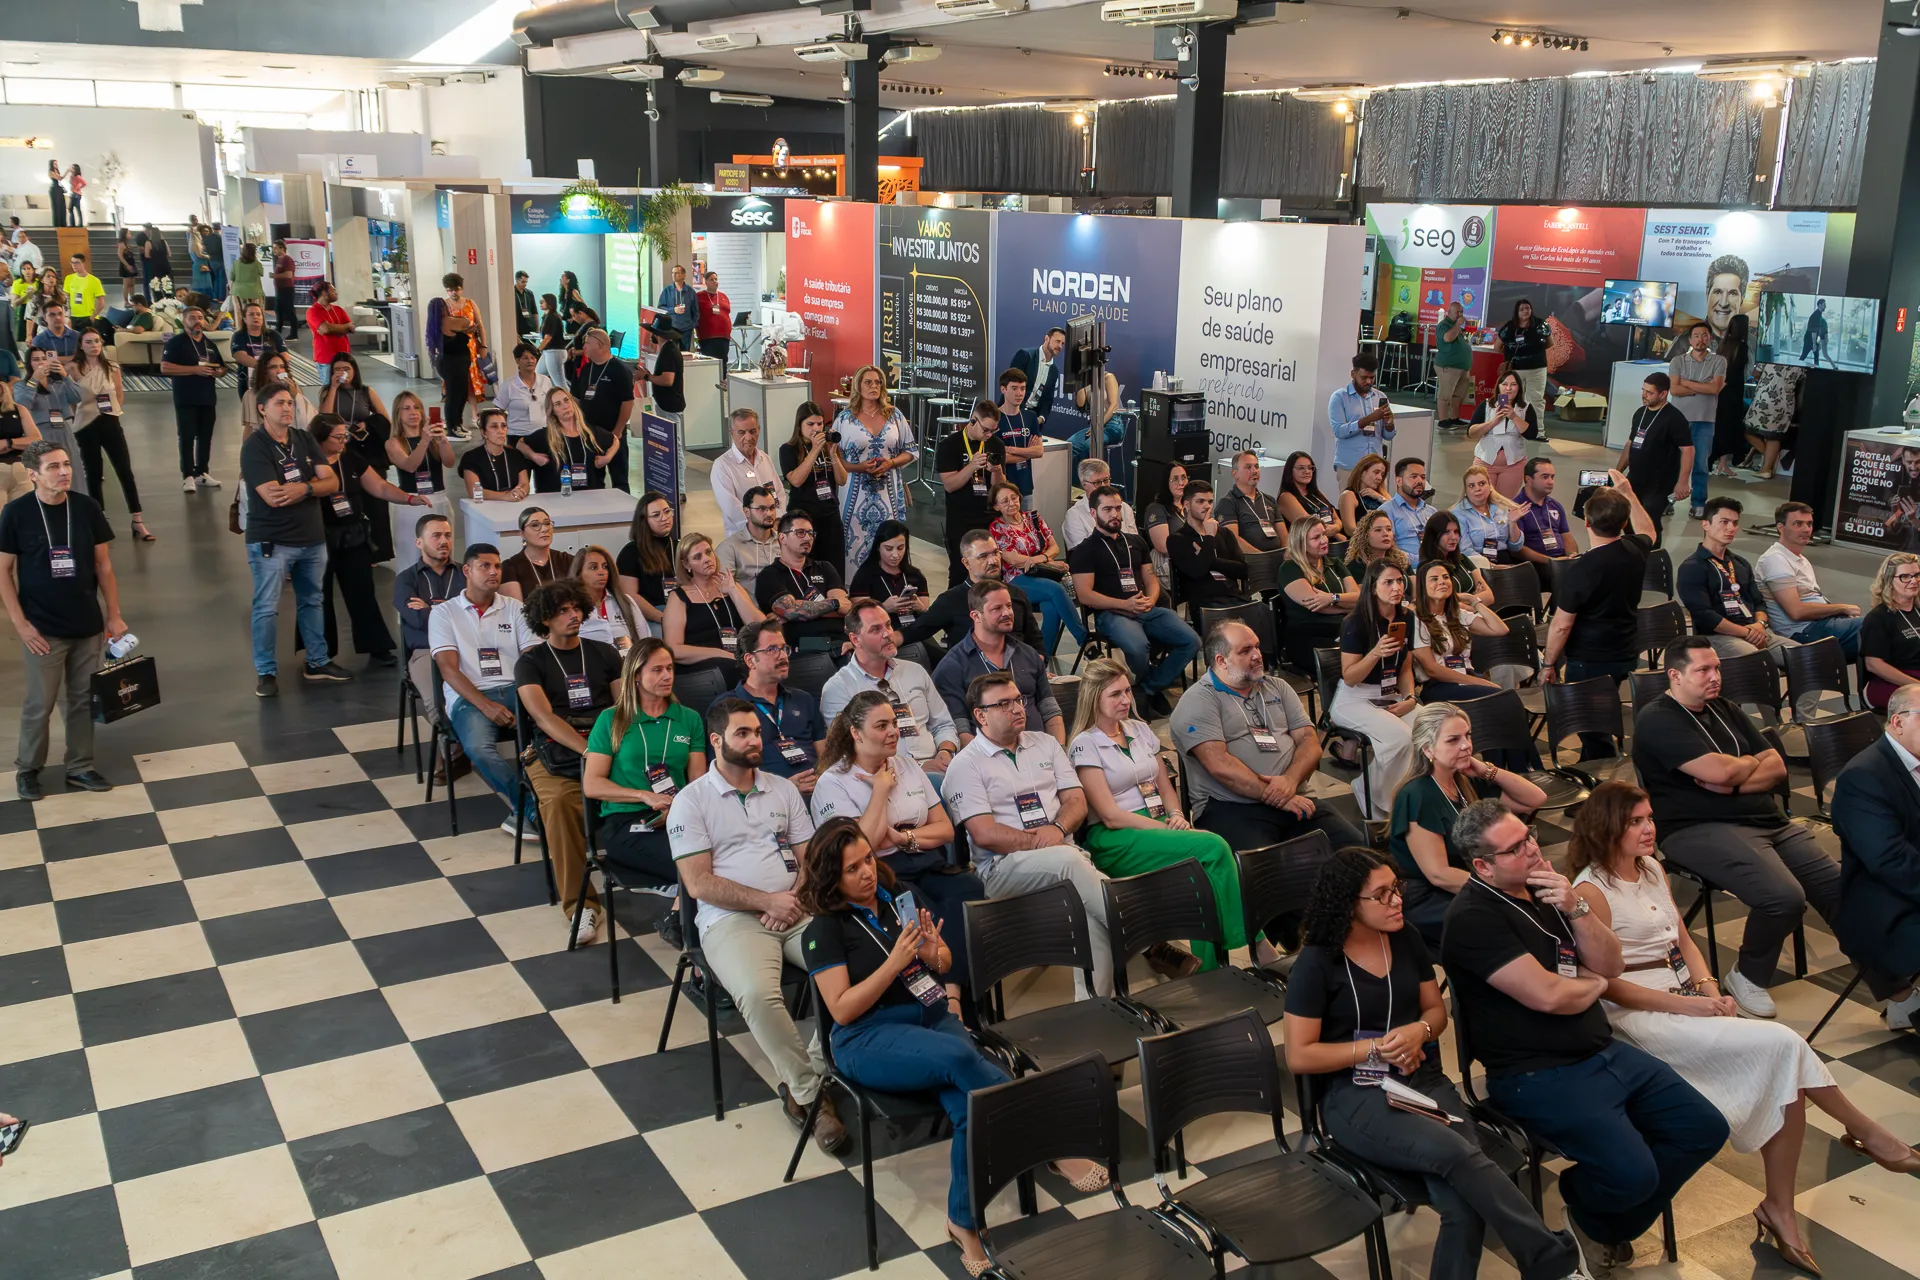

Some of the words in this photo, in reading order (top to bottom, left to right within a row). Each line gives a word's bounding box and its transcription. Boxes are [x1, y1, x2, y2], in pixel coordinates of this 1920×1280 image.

[917, 220, 951, 238] VAMOS
[1471, 223, 1477, 234] 5
[1653, 225, 1678, 234] SEST
[1678, 225, 1710, 235] SENAT.
[892, 236, 936, 260] INVESTIR
[937, 240, 980, 263] JUNTOS
[804, 278, 808, 288] A
[809, 278, 824, 290] saúde
[825, 280, 851, 294] tributária
[1032, 268, 1131, 303] NORDEN
[804, 293, 811, 304] da
[811, 296, 820, 306] sua
[821, 298, 844, 310] empresa
[923, 295, 948, 306] 200.000,00
[1204, 286, 1232, 307] Seu
[1237, 288, 1283, 314] plano
[923, 308, 948, 320] 300.000,00
[1032, 298, 1068, 315] PLANO
[1071, 302, 1086, 316] DE
[1090, 304, 1129, 322] SAÚDE
[804, 312, 823, 324] começa
[824, 315, 834, 324] com
[836, 316, 839, 326] a
[883, 291, 894, 344] RREI
[812, 326, 828, 339] Fiscal.
[923, 322, 948, 334] 500.000,00
[1202, 316, 1221, 338] de
[1225, 320, 1274, 345] saúde
[923, 343, 948, 356] 100.000,00
[1200, 352, 1296, 382] empresarial
[1199, 377, 1264, 404] preferido
[1208, 398, 1256, 423] anhou
[1261, 410, 1287, 429] um
[1854, 450, 1891, 463] PROTEJA
[1852, 467, 1871, 476] COM
[1873, 470, 1886, 478] UM
[1861, 460, 1878, 468] QUE
[1885, 464, 1901, 472] SEU
[1850, 484, 1868, 493] APP.
[1852, 475, 1878, 486] TOQUE
[1880, 479, 1893, 488] NO
[1844, 522, 1884, 537] 8.000
[1849, 518, 1883, 527] ENGEFORT
